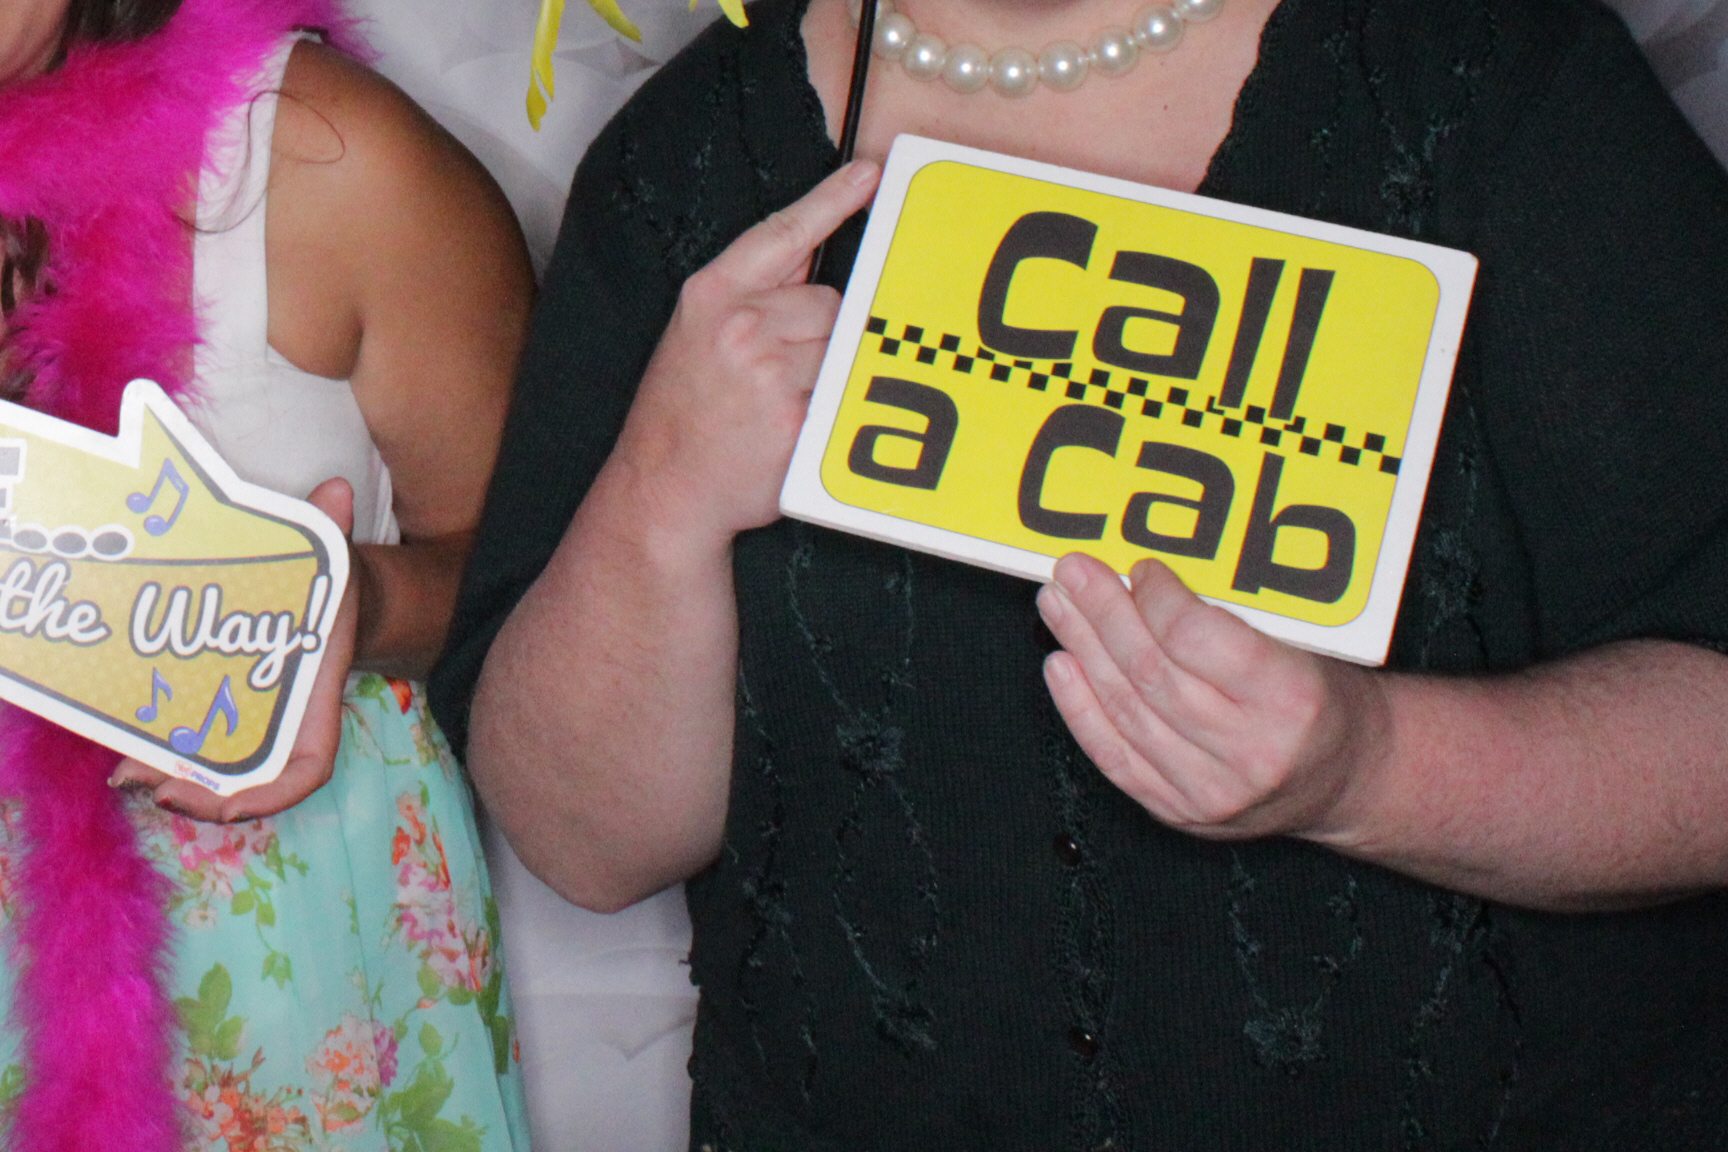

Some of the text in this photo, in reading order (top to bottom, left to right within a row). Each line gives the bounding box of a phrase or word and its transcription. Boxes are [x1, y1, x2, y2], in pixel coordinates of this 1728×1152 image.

[976, 211, 1336, 421] Call
[847, 375, 1357, 604] a Cab
[129, 573, 332, 692] Way!
